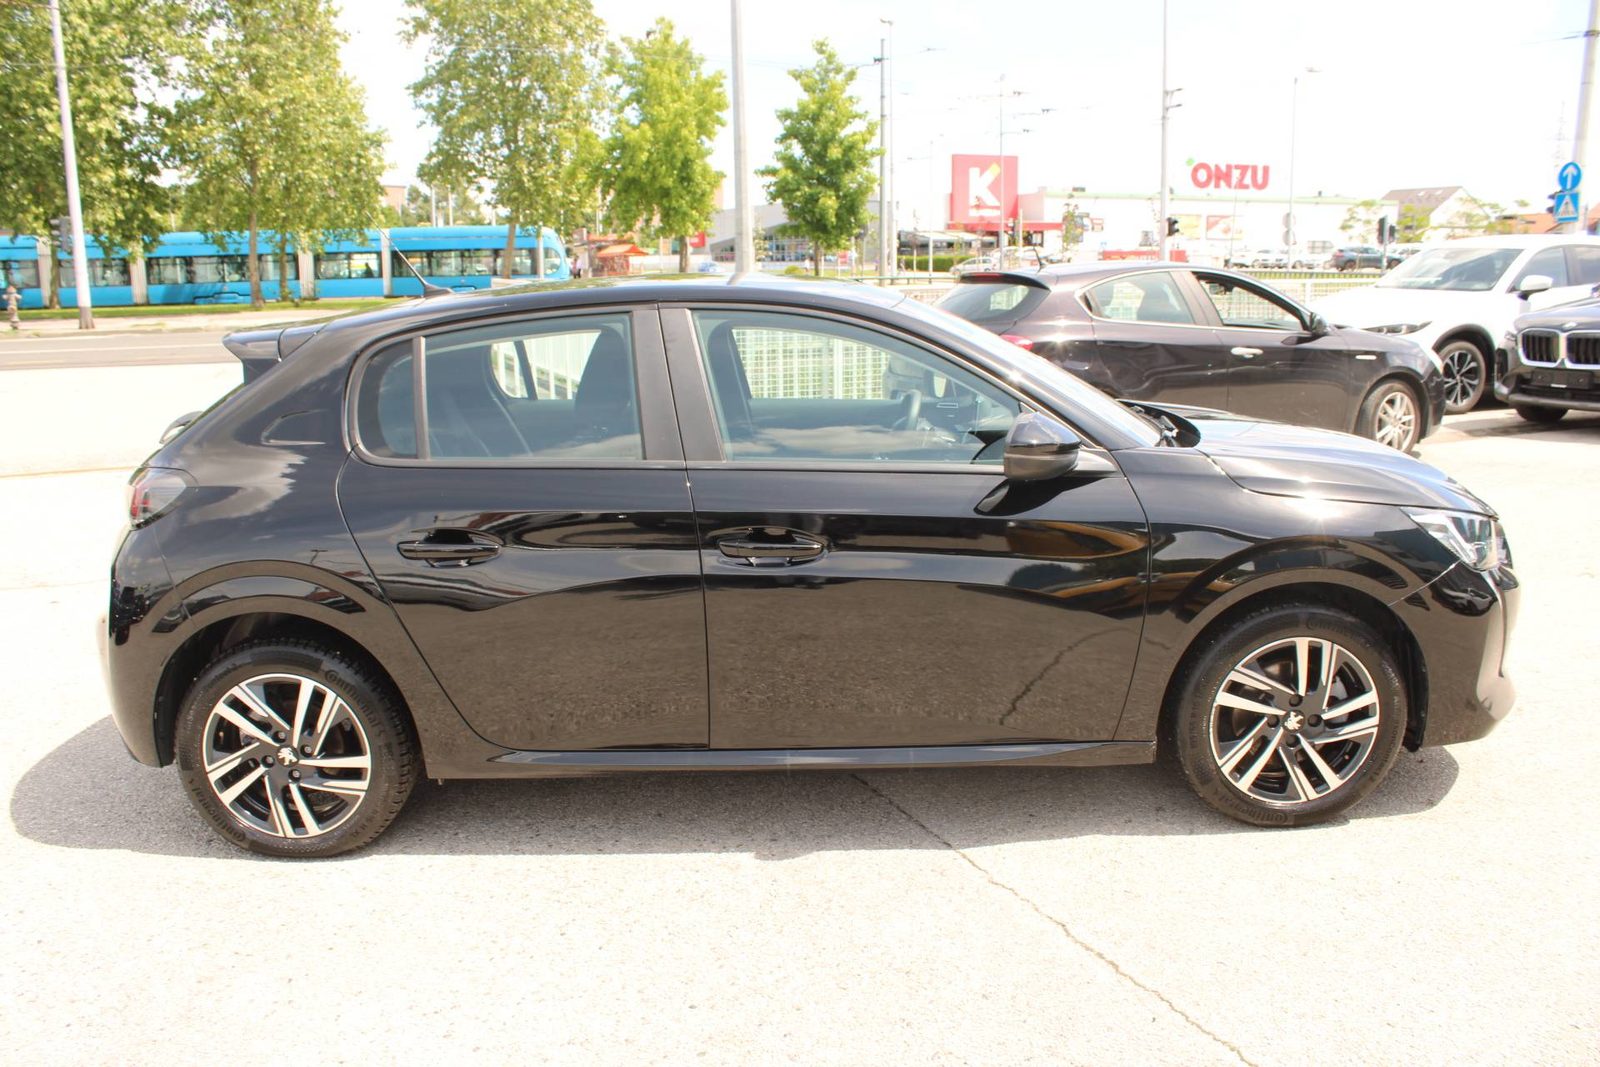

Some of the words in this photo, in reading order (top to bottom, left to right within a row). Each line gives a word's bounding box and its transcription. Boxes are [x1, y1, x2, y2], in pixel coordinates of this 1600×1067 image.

[968, 162, 1001, 207] K
[325, 669, 382, 728] Continental
[191, 787, 247, 842] Continental
